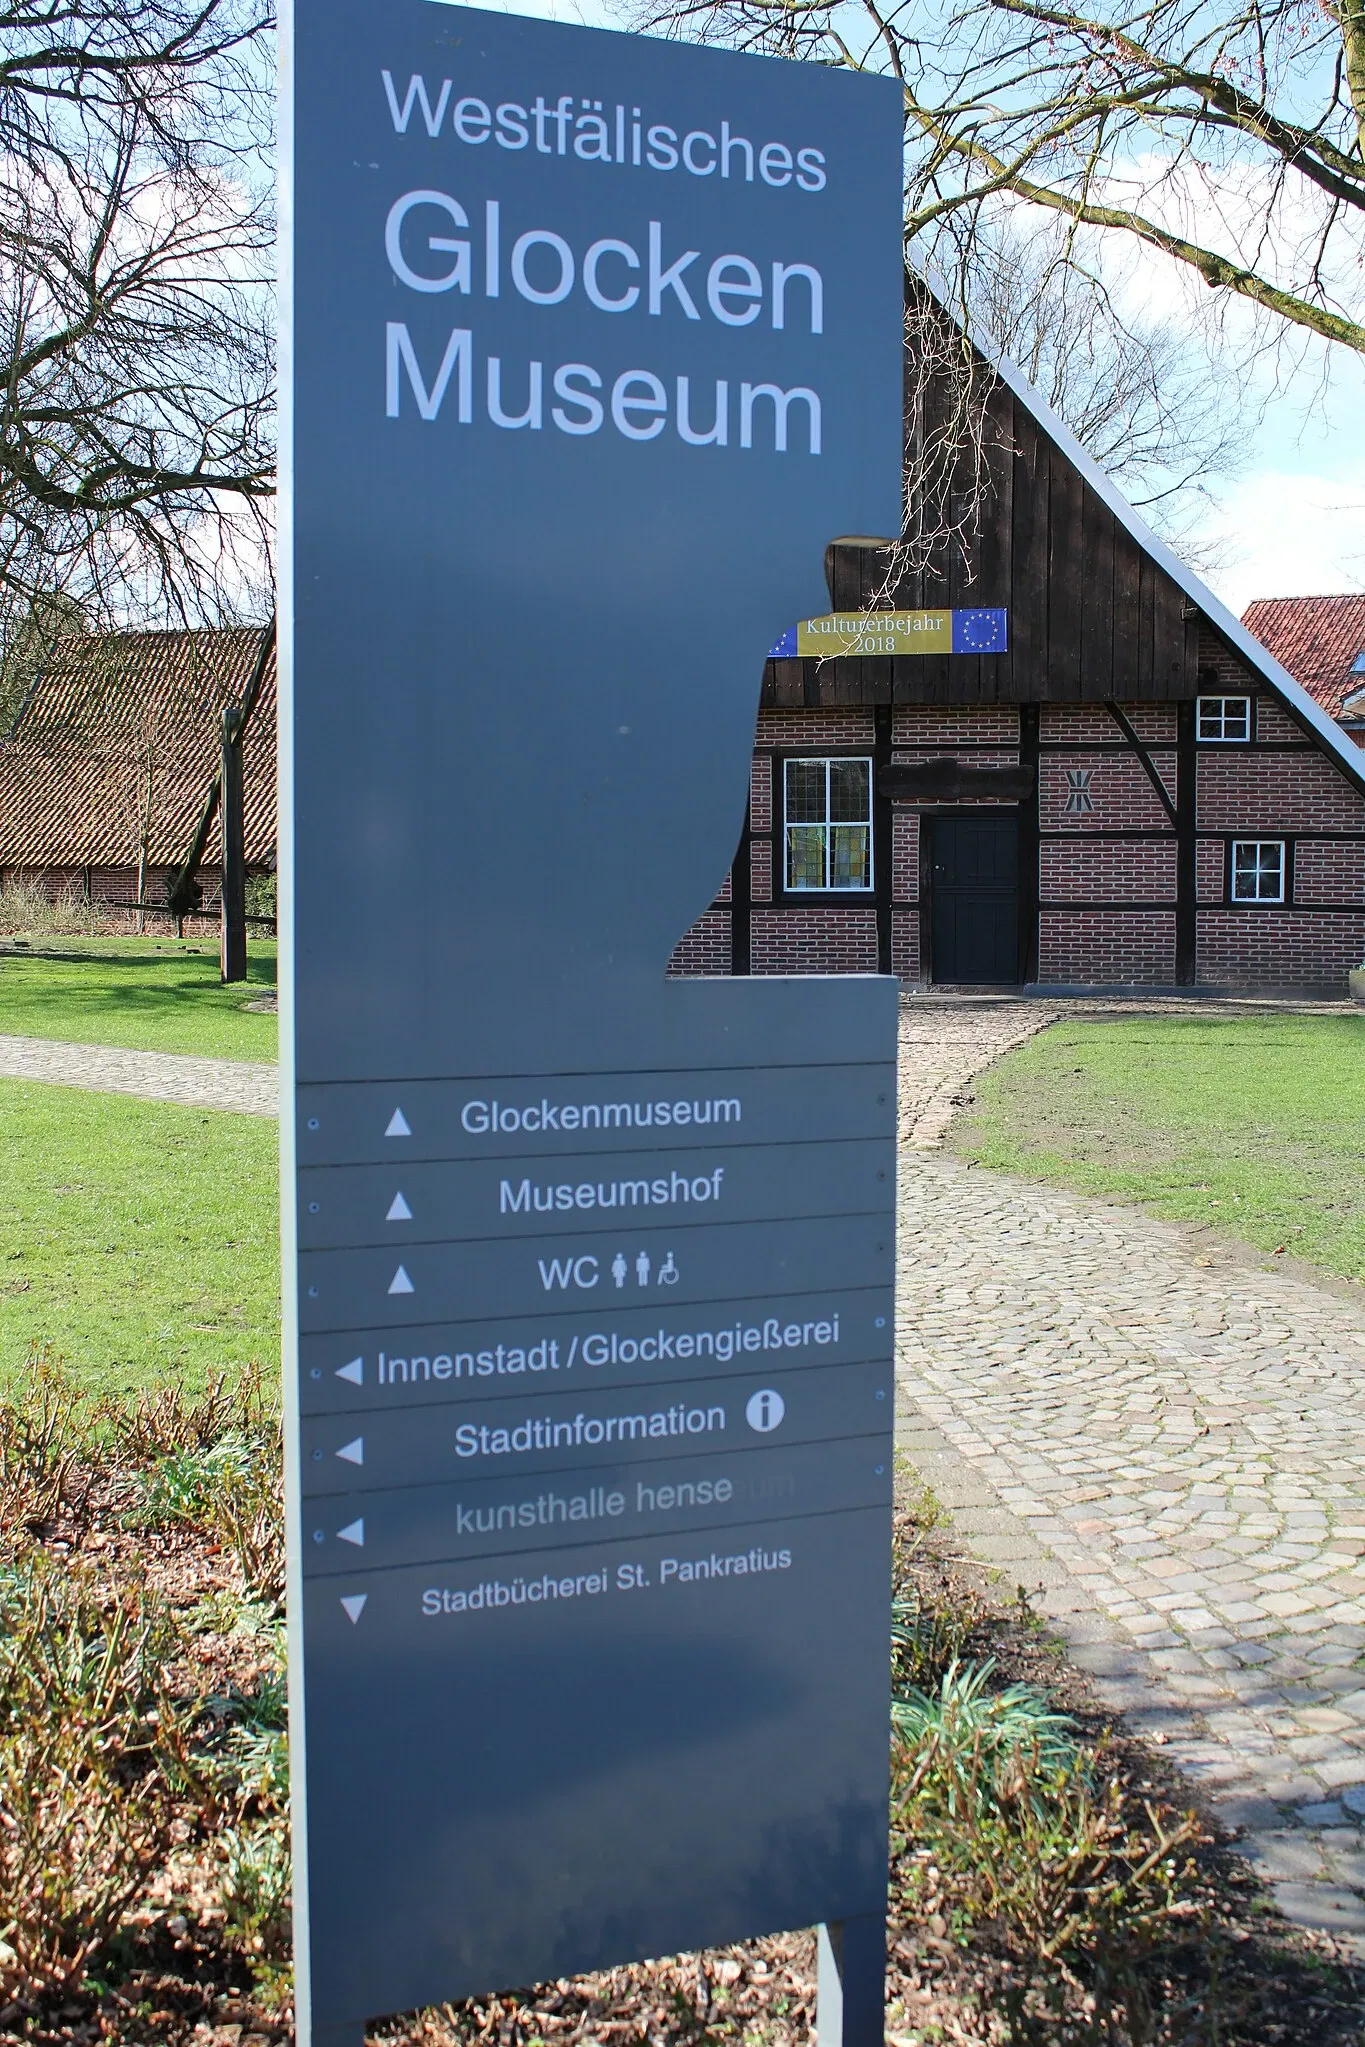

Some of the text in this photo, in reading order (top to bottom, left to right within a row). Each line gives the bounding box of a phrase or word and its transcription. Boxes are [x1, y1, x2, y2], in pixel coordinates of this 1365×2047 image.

[381, 69, 827, 192] Westfälisches
[384, 189, 823, 334] Glocken
[385, 321, 822, 455] Museum
[806, 614, 943, 635] Kulturerbejahr
[854, 636, 895, 653] 2018
[460, 1098, 742, 1134] Glockenmuseum
[499, 1167, 724, 1214] Museumshof
[537, 1255, 600, 1291] WC
[378, 1338, 560, 1385] Innenstadt
[454, 1403, 726, 1458] Stadtinformation
[456, 1487, 626, 1534] kunsthalle
[636, 1477, 733, 1513] hense
[421, 1547, 793, 1616] Stadtbücherei St. Pankratius
